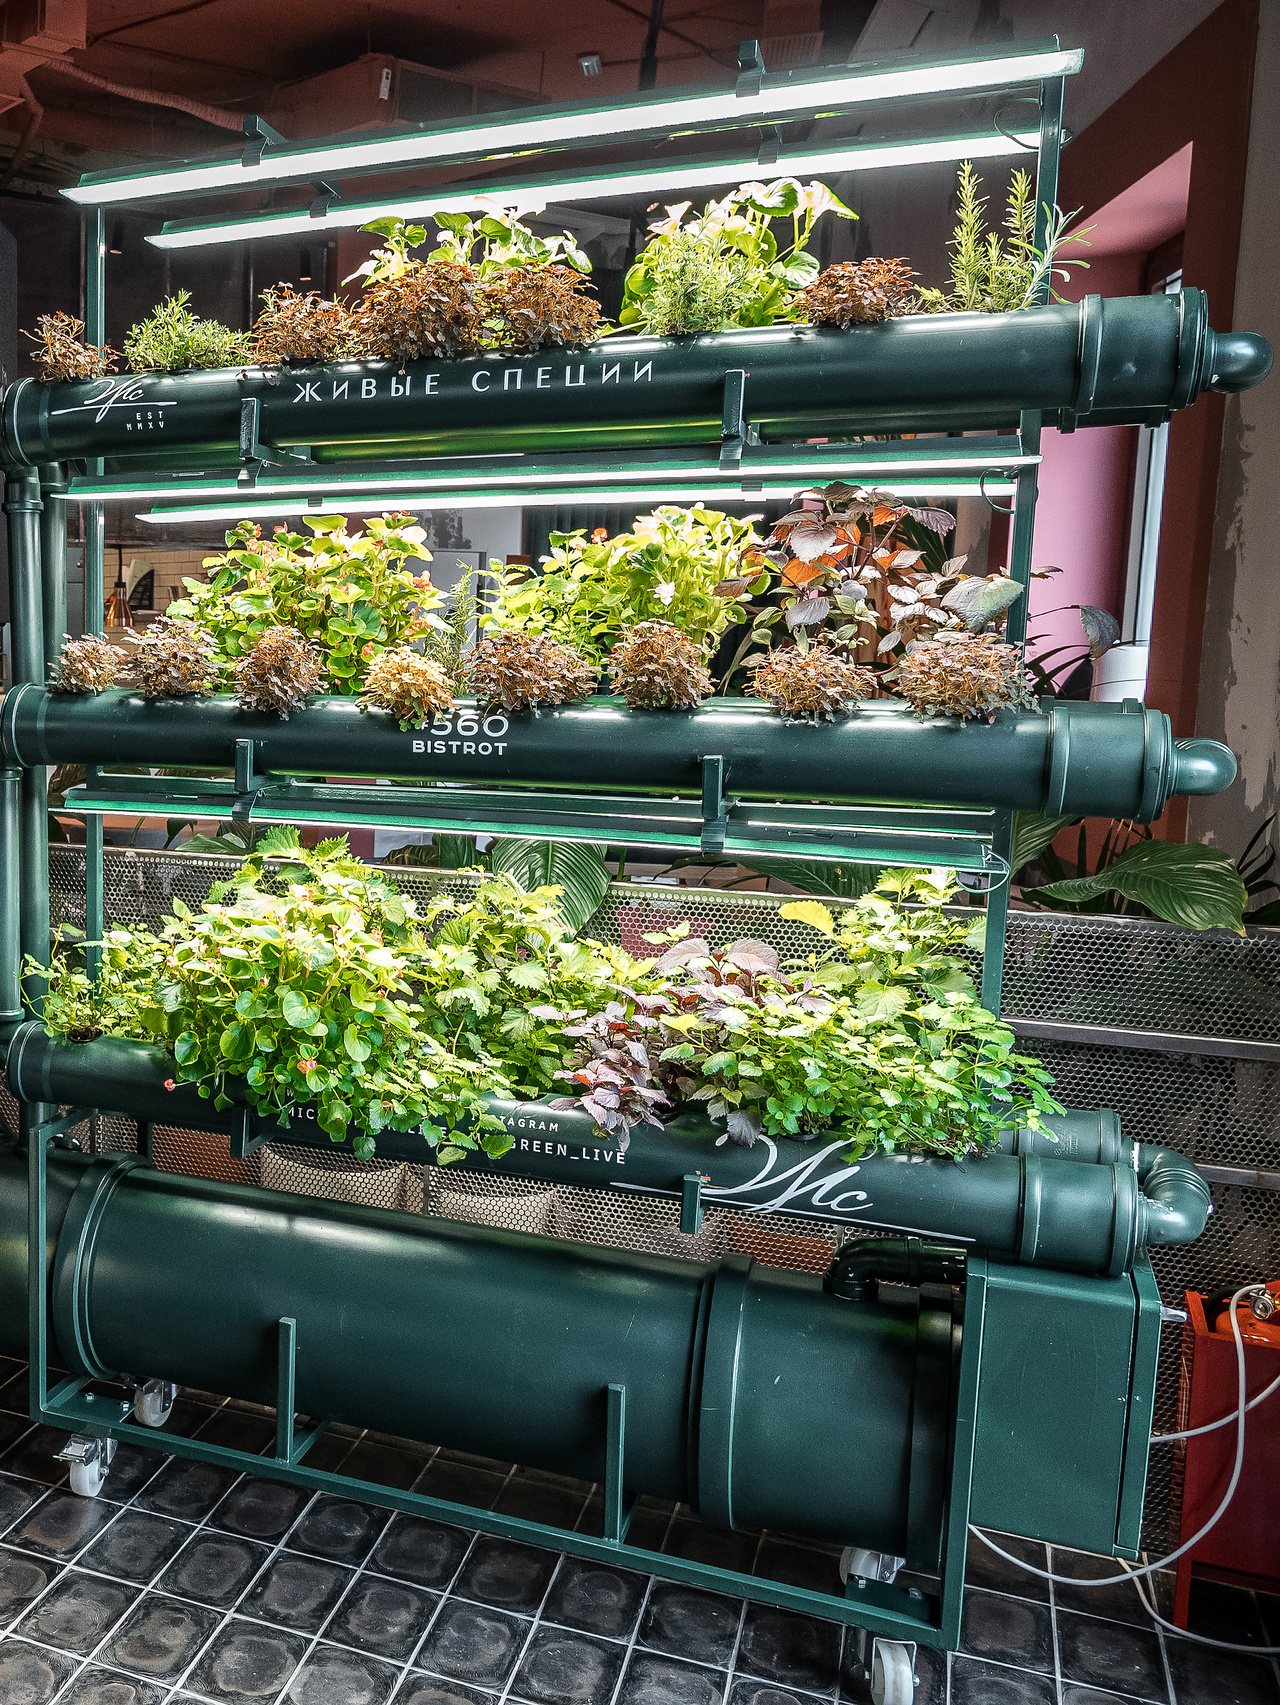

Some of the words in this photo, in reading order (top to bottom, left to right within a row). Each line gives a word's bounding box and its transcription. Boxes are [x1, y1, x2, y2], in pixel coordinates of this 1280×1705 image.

[292, 373, 441, 404] ЖИВЫЕ
[471, 360, 653, 393] СПЕЦИИ
[136, 411, 163, 420] EST
[126, 421, 164, 431] MMXV
[412, 740, 508, 756] BISTROT
